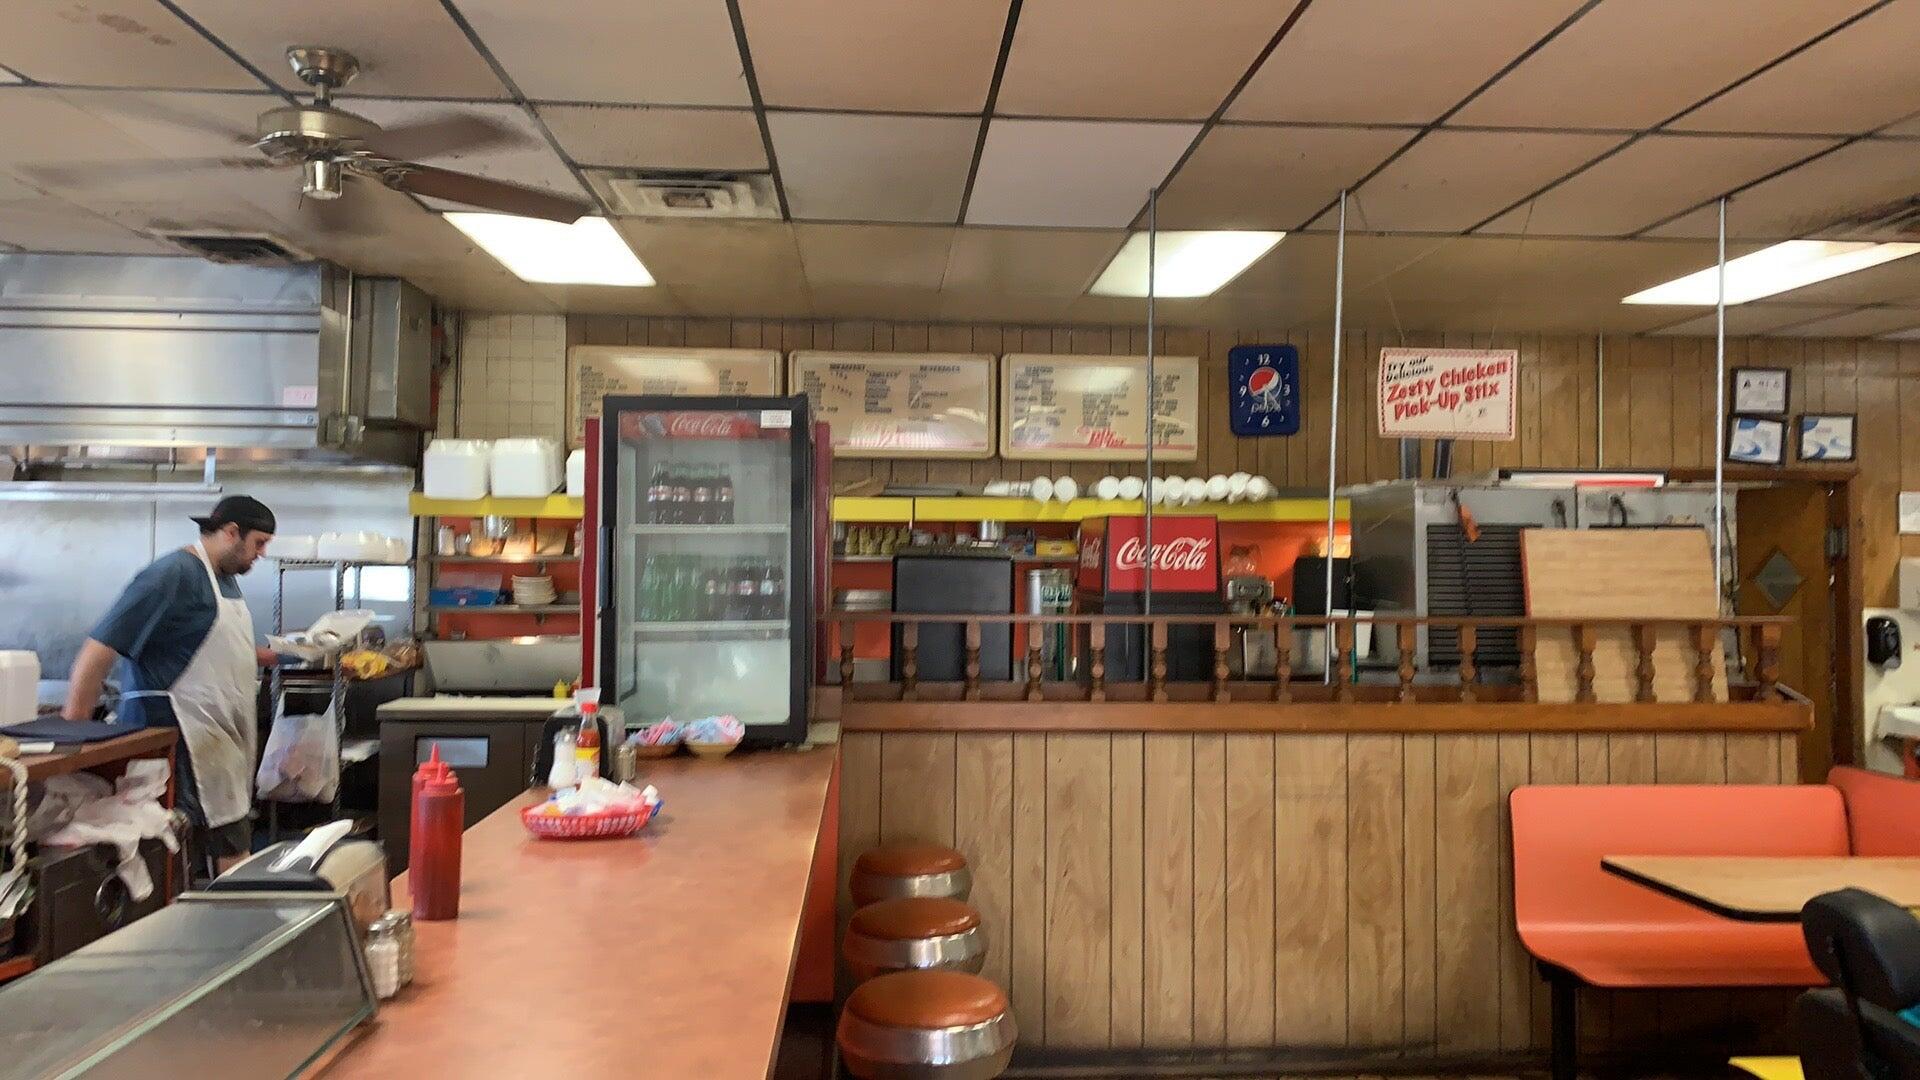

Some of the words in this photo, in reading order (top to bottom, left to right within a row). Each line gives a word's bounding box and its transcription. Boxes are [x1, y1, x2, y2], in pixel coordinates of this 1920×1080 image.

[1258, 353, 1270, 366] 12
[1409, 356, 1429, 366] our
[1386, 364, 1434, 382] Delicious
[1387, 379, 1437, 402] Zesty
[1440, 360, 1509, 388] Chicken
[1239, 385, 1247, 398] 9
[1283, 384, 1291, 397] 3
[1394, 391, 1461, 421] Pick-Up
[1464, 381, 1500, 403] Stix
[1261, 415, 1270, 428] 6
[1115, 536, 1212, 571] Coca-Cola
